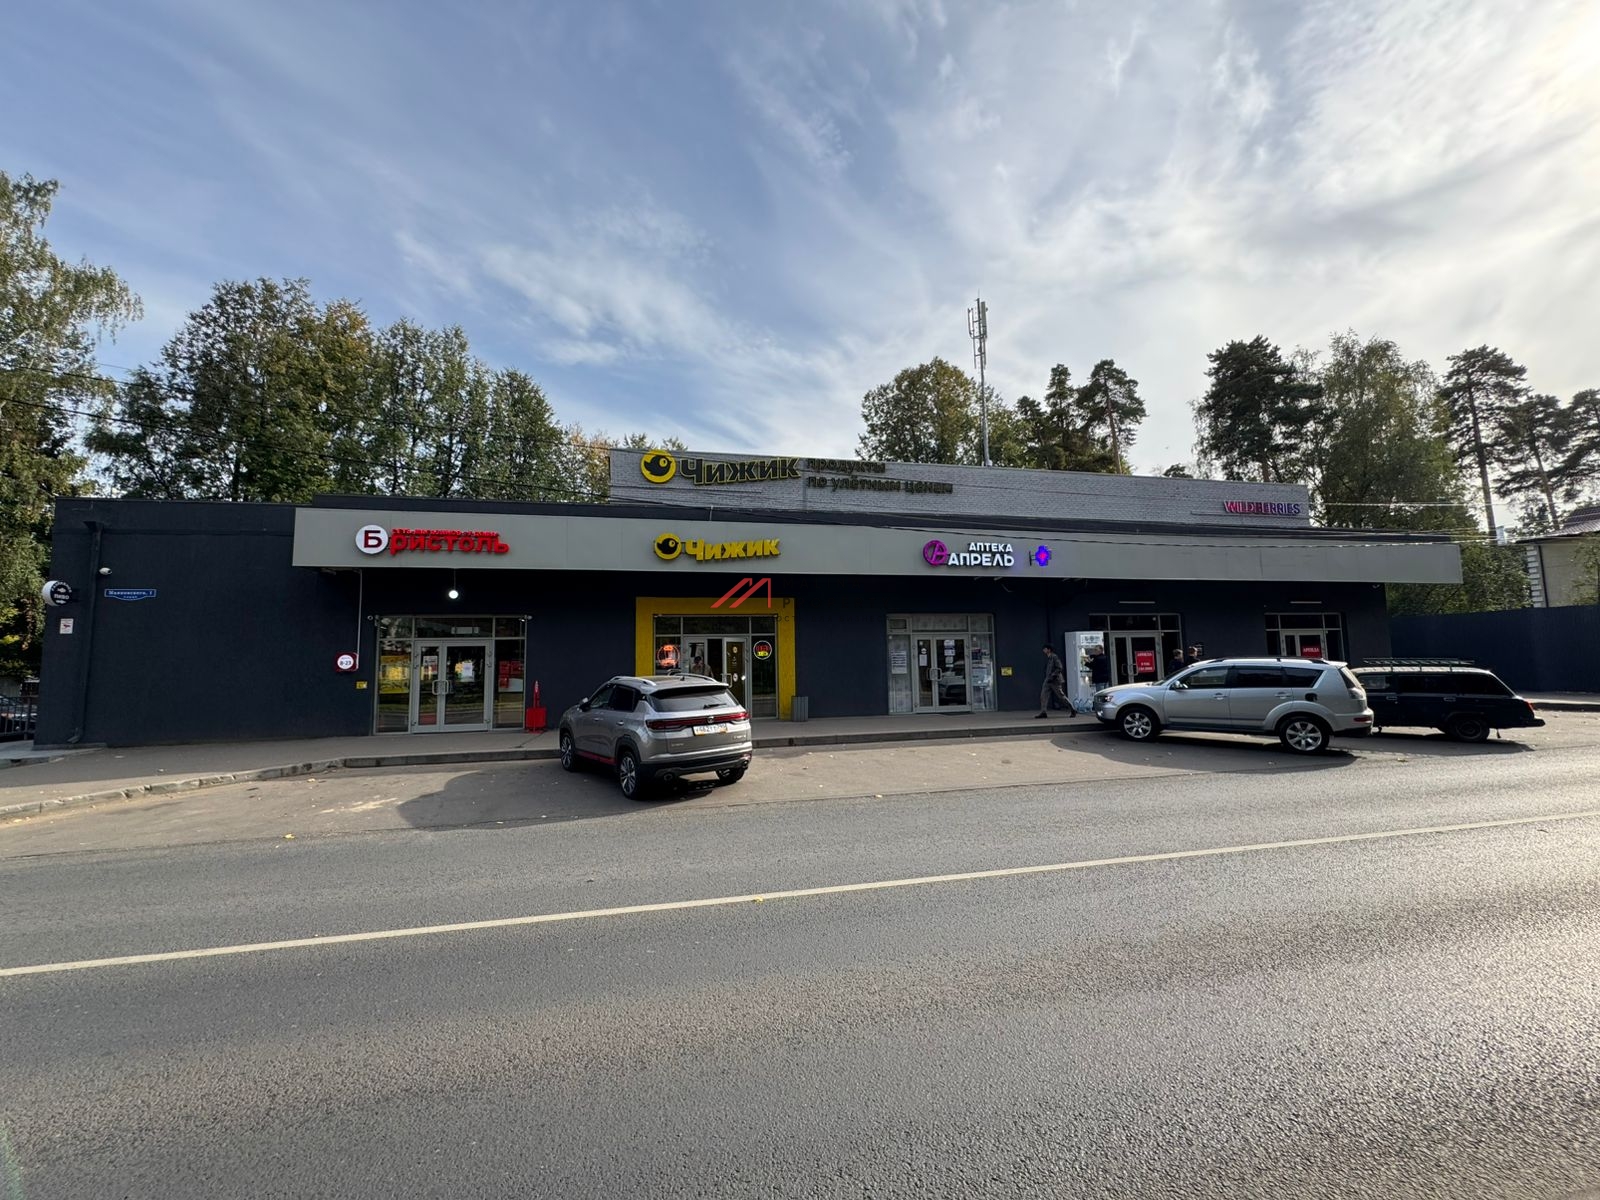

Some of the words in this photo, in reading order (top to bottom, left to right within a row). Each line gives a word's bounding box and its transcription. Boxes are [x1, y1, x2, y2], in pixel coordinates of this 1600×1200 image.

[680, 456, 801, 485] Чижик
[1223, 500, 1301, 515] WILDBERRIES
[685, 538, 781, 561] Чижик
[968, 542, 1013, 553] АПТЕКА
[947, 552, 1015, 567] АПРЕЛЬ
